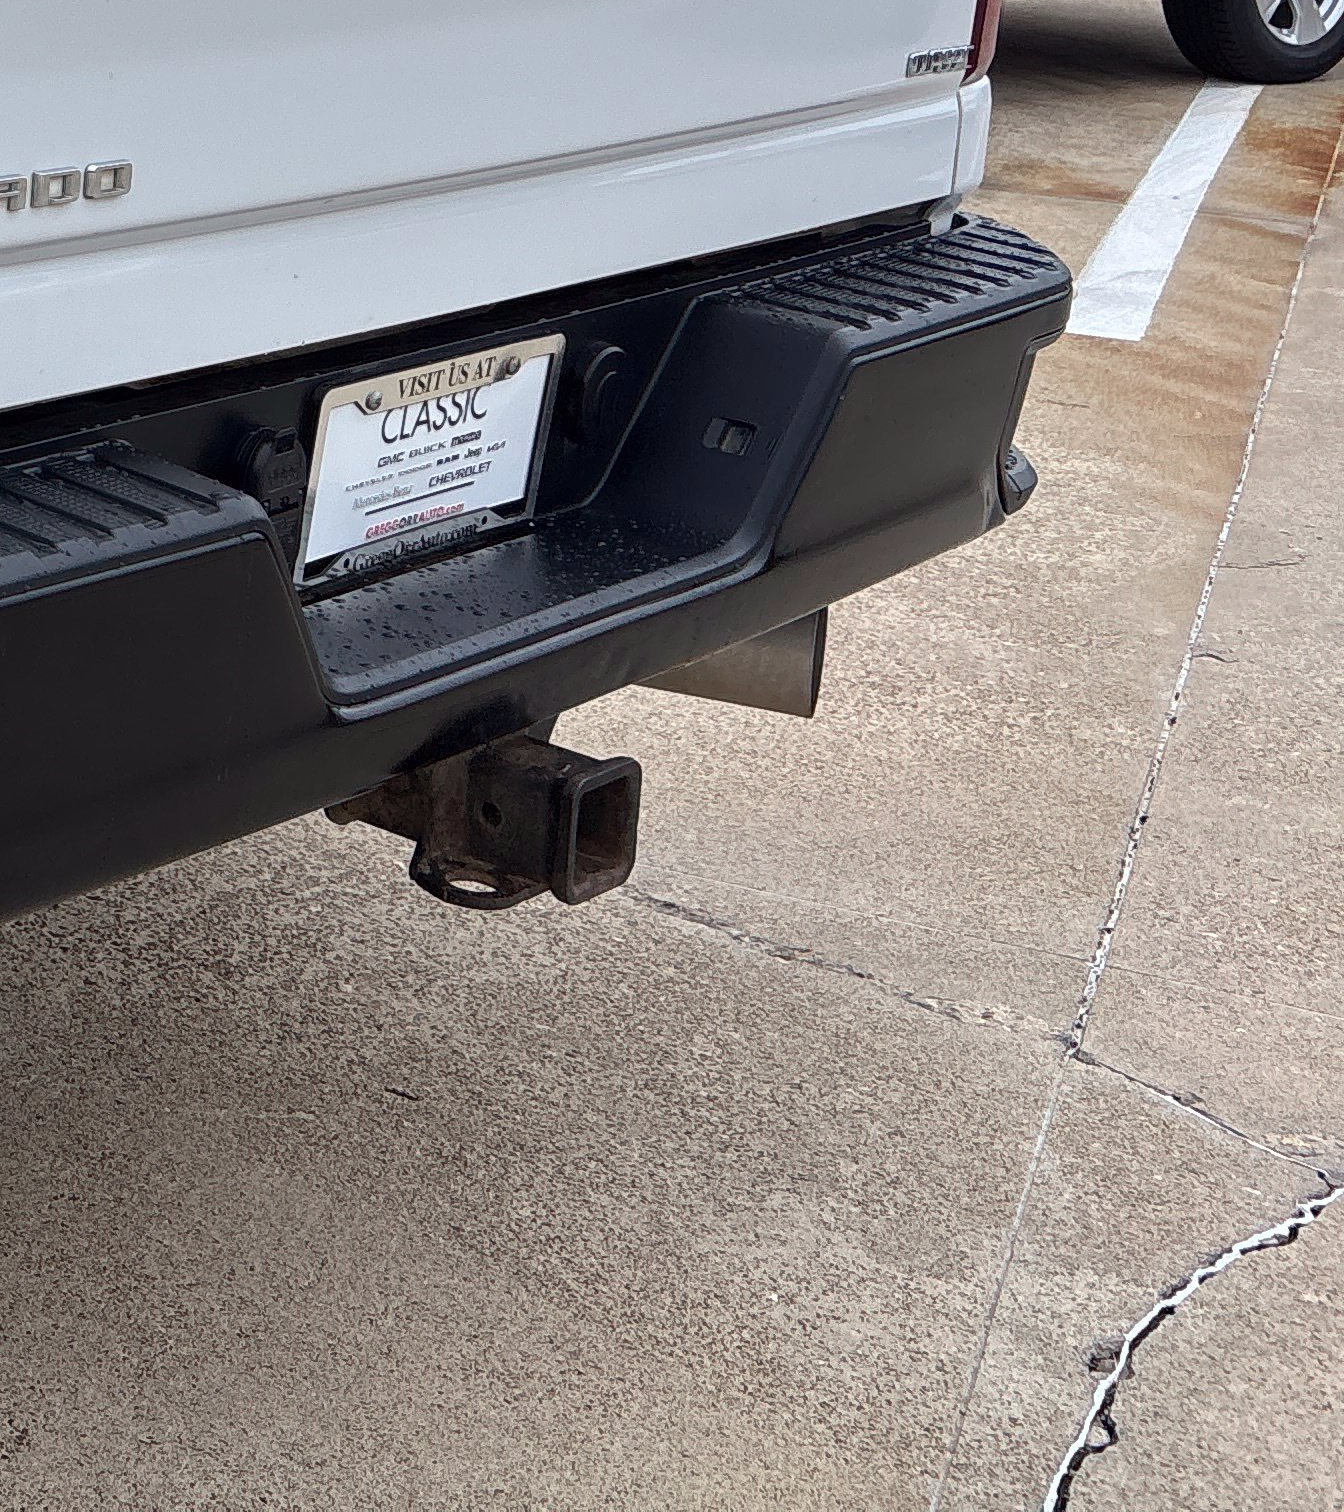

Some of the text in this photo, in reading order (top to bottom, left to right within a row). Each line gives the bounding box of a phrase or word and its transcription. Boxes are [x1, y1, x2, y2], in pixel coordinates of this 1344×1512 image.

[398, 356, 497, 399] VISIT US AT
[381, 387, 490, 444] CLASSIC
[377, 450, 405, 468] GMC
